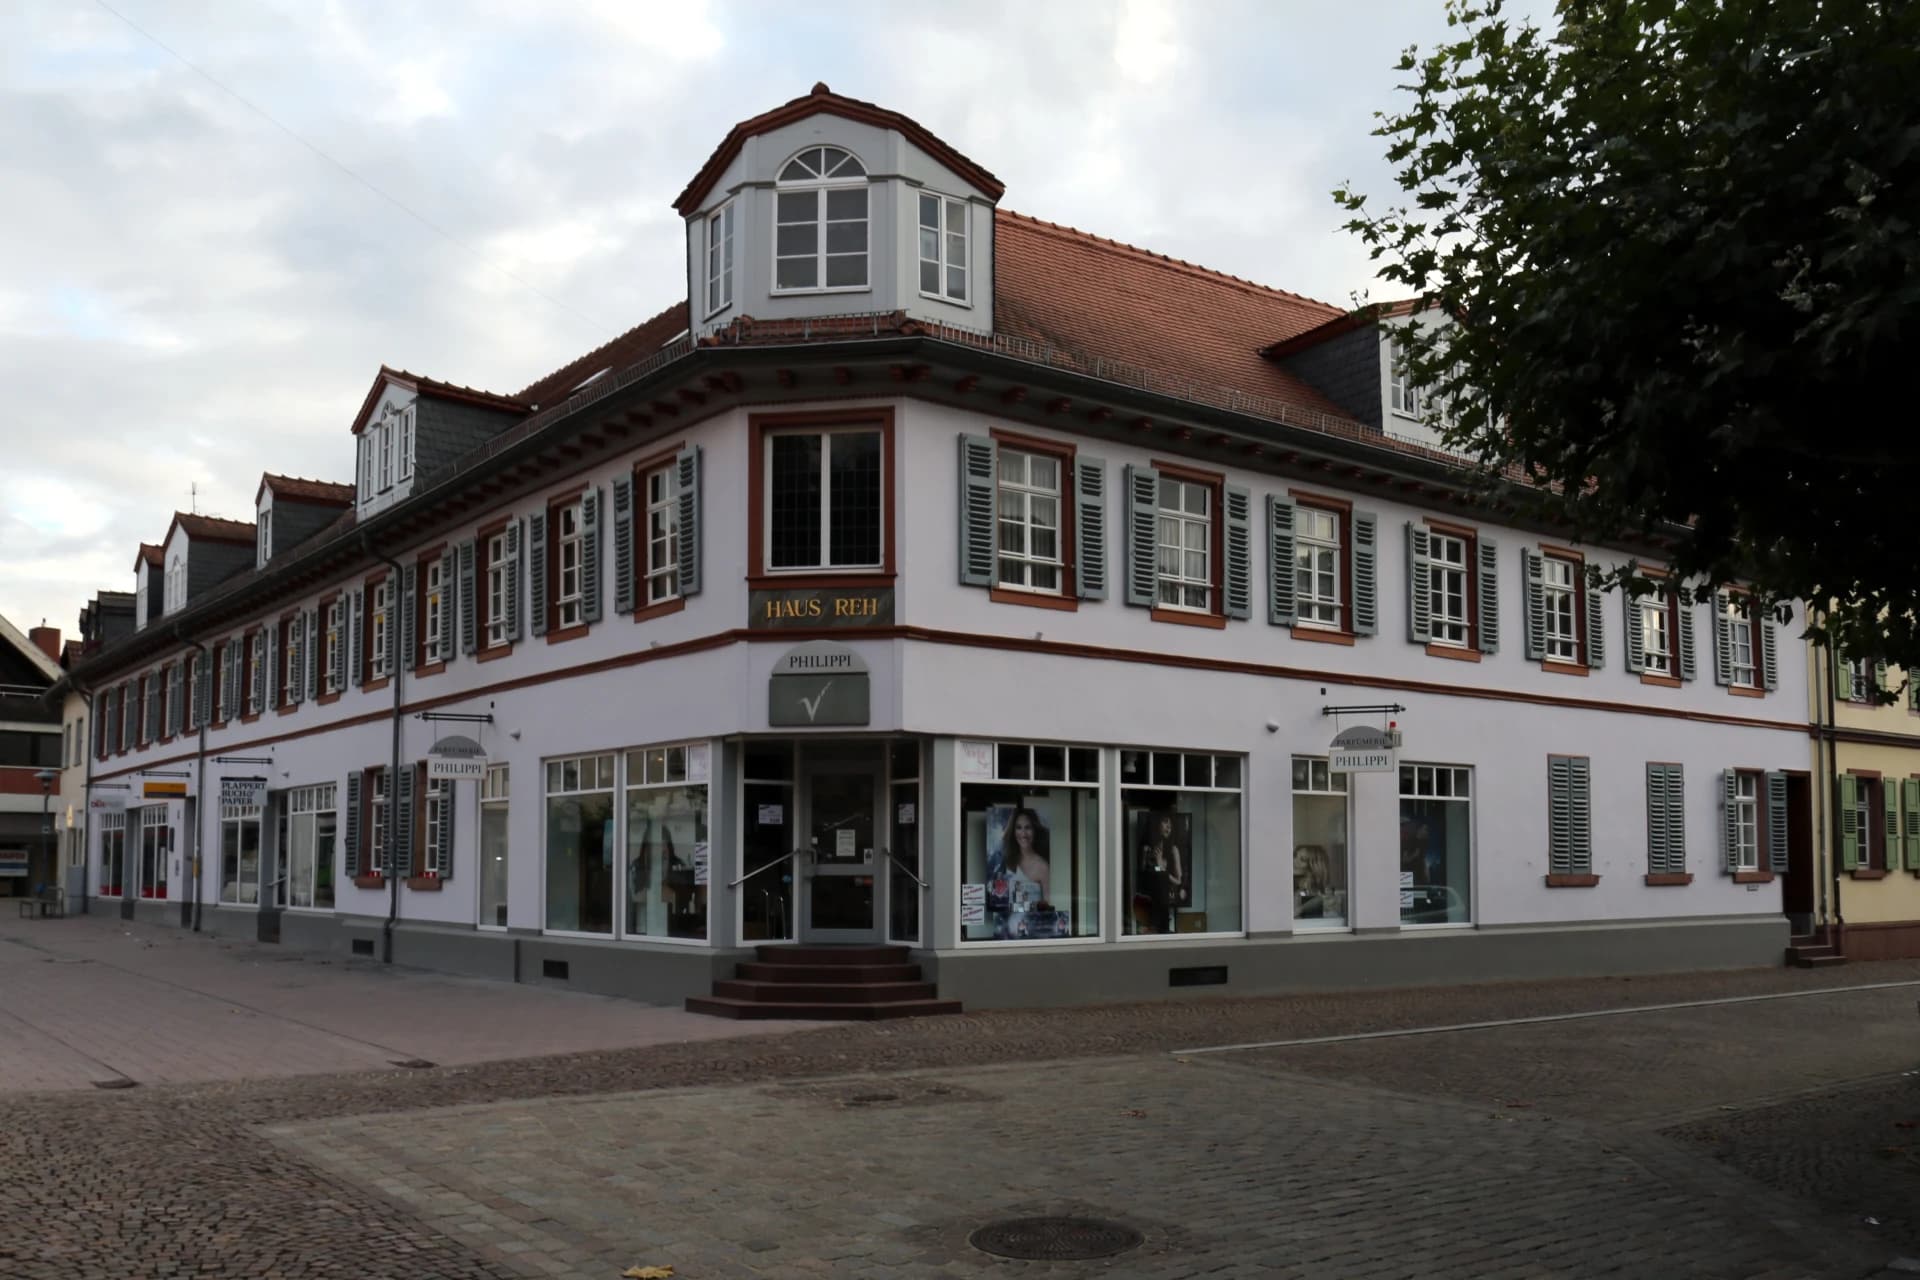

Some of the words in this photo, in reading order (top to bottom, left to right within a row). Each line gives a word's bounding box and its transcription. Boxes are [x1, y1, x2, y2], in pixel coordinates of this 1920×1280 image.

[767, 599, 821, 618] HAUS
[835, 597, 878, 616] REH
[789, 654, 851, 668] PHILIPPI
[1335, 755, 1387, 767] PHILIPPI
[433, 762, 481, 774] PHILIPPI
[222, 781, 265, 790] PLAPPERT
[222, 797, 253, 805] PAPIER
